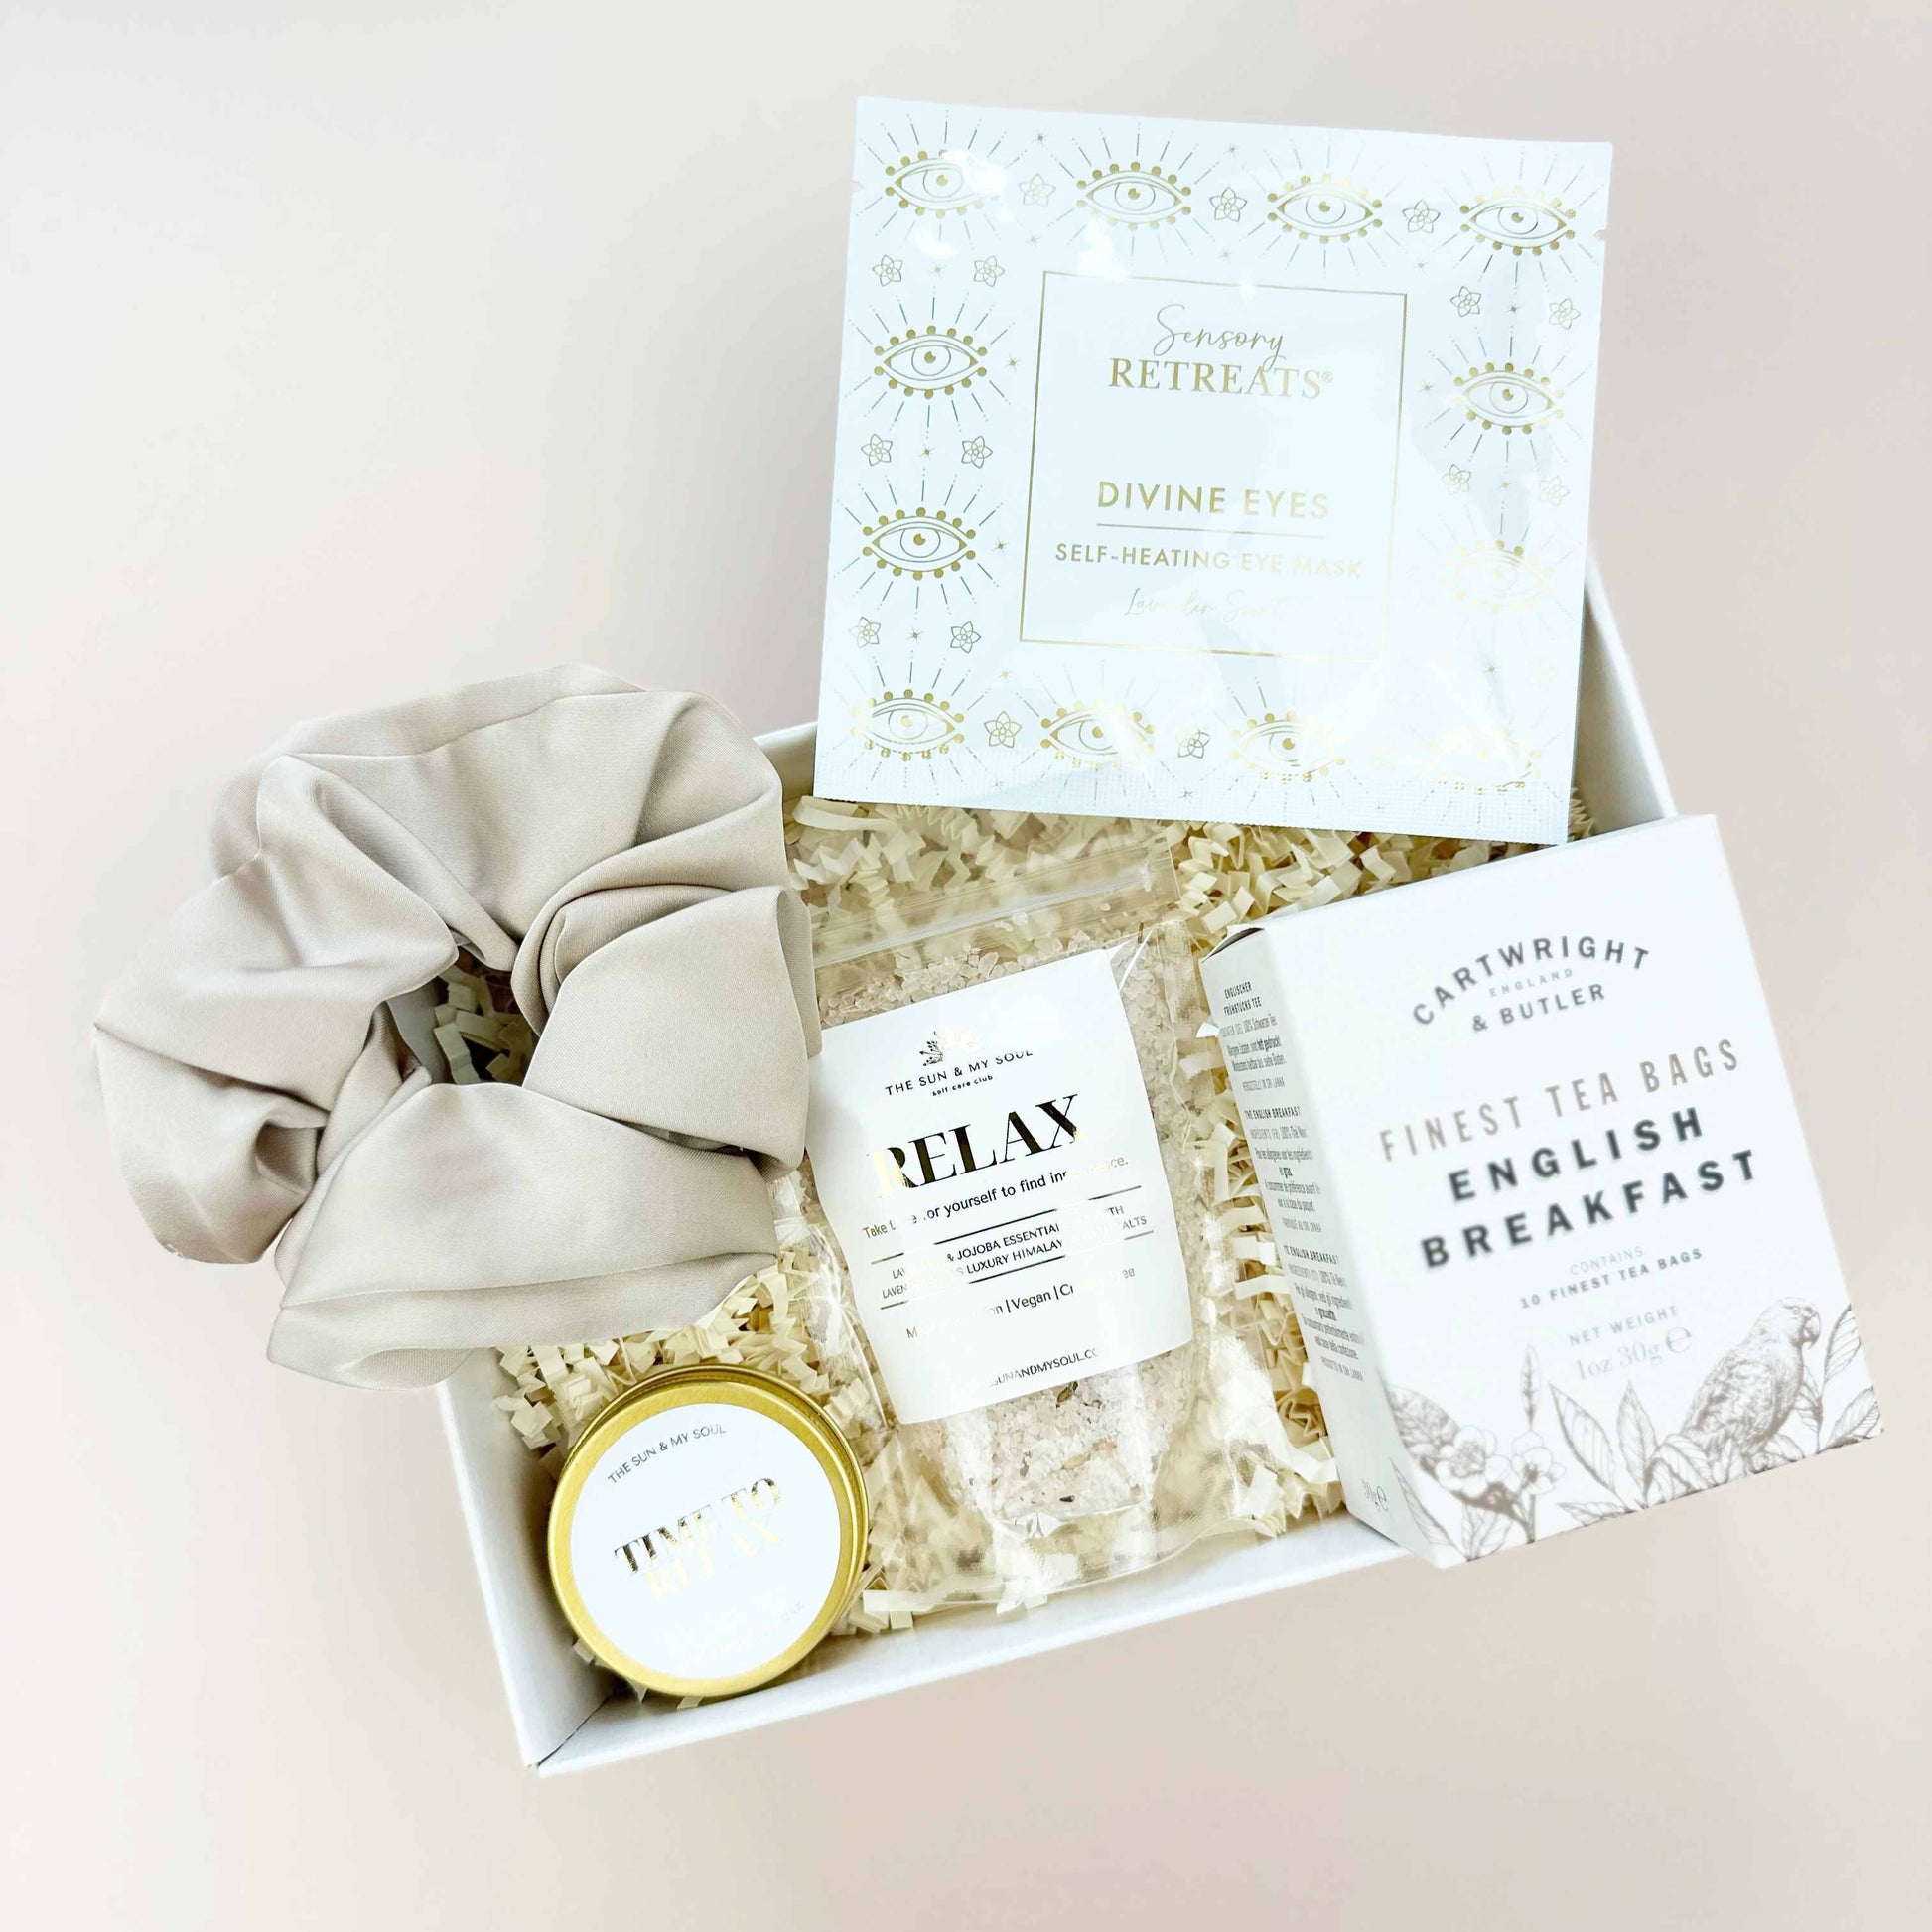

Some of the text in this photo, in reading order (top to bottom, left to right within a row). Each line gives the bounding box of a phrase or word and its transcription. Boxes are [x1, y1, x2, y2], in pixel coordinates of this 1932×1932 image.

[1153, 303, 1287, 369] Sensory
[1097, 481, 1329, 520] DIVINE EYES
[1055, 543, 1362, 578] SELF-HEATING EYE MASK
[1413, 935, 1650, 1027] CARTWRIGHT
[1489, 967, 1575, 998] ENGLAND
[1471, 983, 1605, 1033] & BUTLER
[885, 1050, 1034, 1096] THE SUN & MY SOUL
[952, 1080, 972, 1091] care
[974, 1074, 994, 1085] club
[1380, 1038, 1739, 1163] FINEST TEA BAGS
[867, 1094, 1085, 1197] RELAX
[1448, 1107, 1704, 1203] ENGLISH
[862, 1224, 889, 1239] Take
[922, 1205, 940, 1220] or
[944, 1189, 999, 1218] yourself
[1001, 1185, 1017, 1198] to
[1020, 1174, 1046, 1193] find
[1421, 1149, 1755, 1269] BREAKFAST
[946, 1253, 954, 1262] &
[957, 1240, 1001, 1261] JOJOBA
[966, 1253, 1009, 1275] LUXURY
[1569, 1246, 1644, 1277] CONTAINS
[1520, 1247, 1703, 1310] 10 FINEST TEA BAGS
[1569, 1304, 1678, 1347] NET WEIGHT
[608, 1423, 727, 1484] THE SUN & MY SOUL
[721, 1477, 782, 1524] TO
